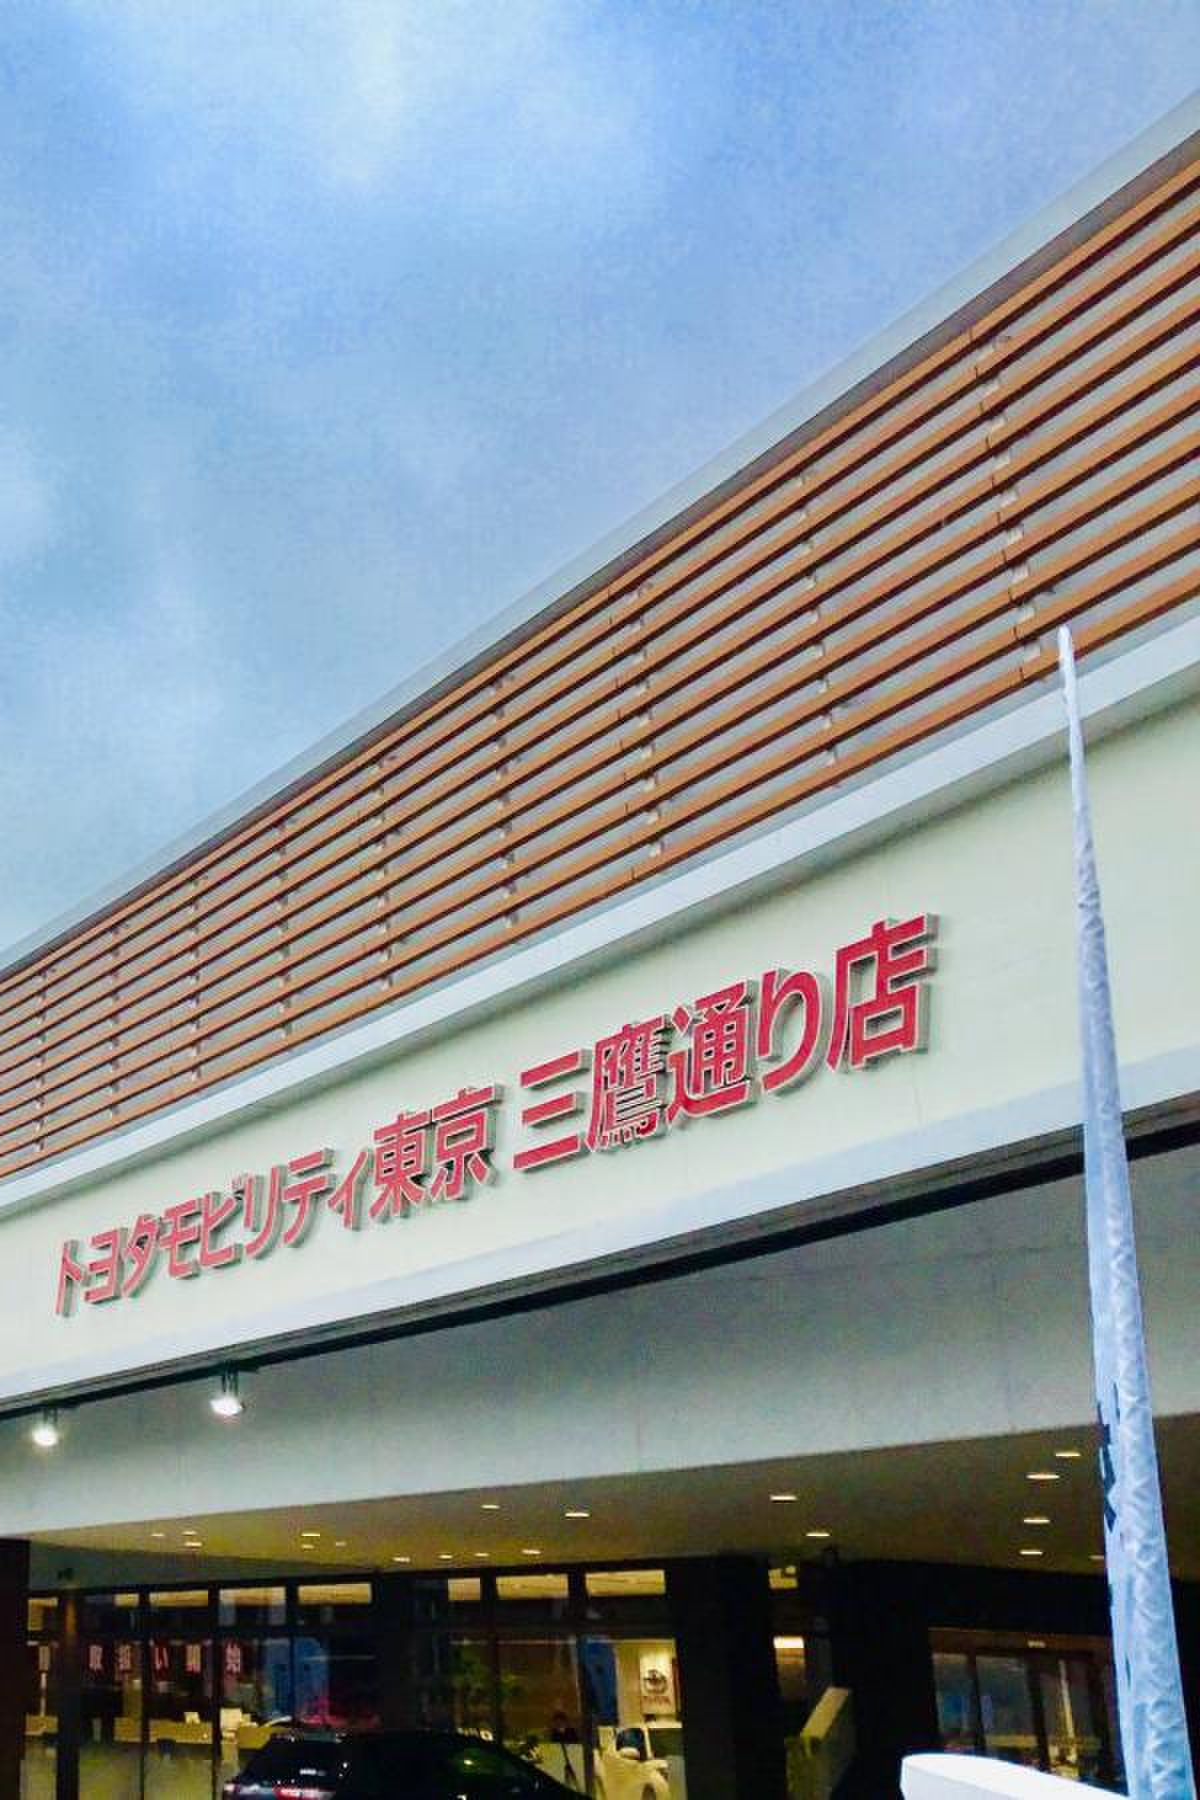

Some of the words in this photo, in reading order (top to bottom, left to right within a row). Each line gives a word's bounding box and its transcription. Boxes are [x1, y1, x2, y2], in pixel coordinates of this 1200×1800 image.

[56, 1086, 501, 1316] トヨタモビリティ東京
[513, 912, 936, 1171] 三鷹通り店
